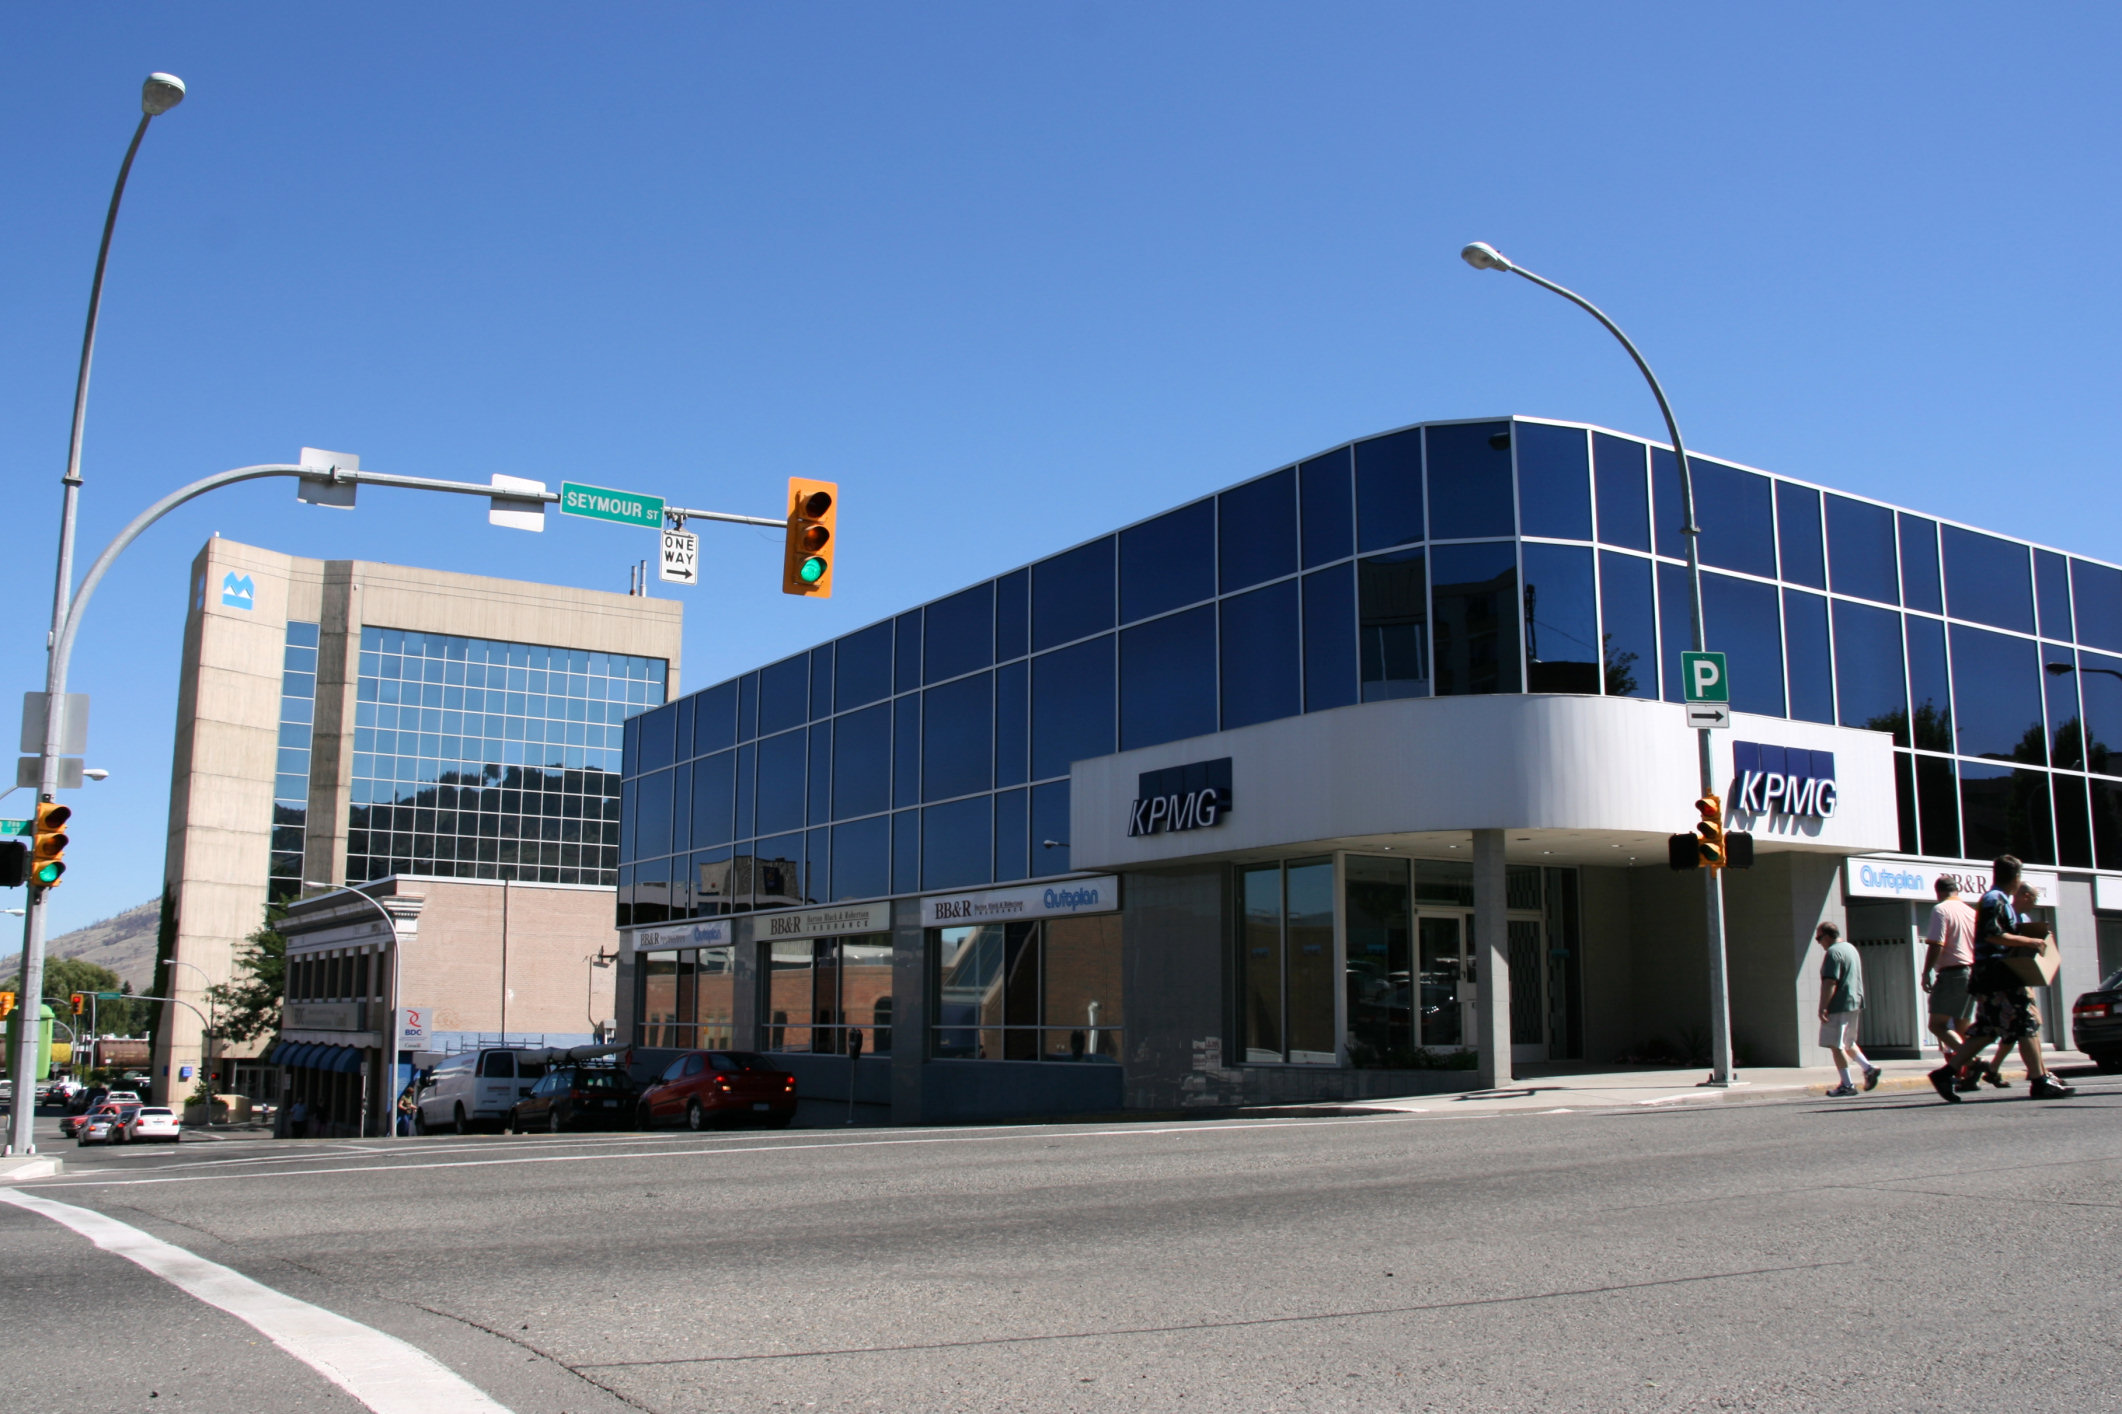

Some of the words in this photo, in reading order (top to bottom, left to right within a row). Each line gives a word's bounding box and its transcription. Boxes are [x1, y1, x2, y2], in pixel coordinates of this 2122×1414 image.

[567, 491, 642, 518] SEYMOUR
[646, 509, 660, 521] ST
[664, 536, 694, 551] ONE
[664, 550, 694, 565] WAY
[1693, 660, 1720, 698] P
[1738, 769, 1837, 819] KPMG
[1128, 788, 1218, 837] KPMG
[1940, 873, 1988, 894] B&R
[935, 900, 972, 920] BB&R
[1043, 887, 1099, 912] Autoplan
[770, 915, 802, 935] BB&R
